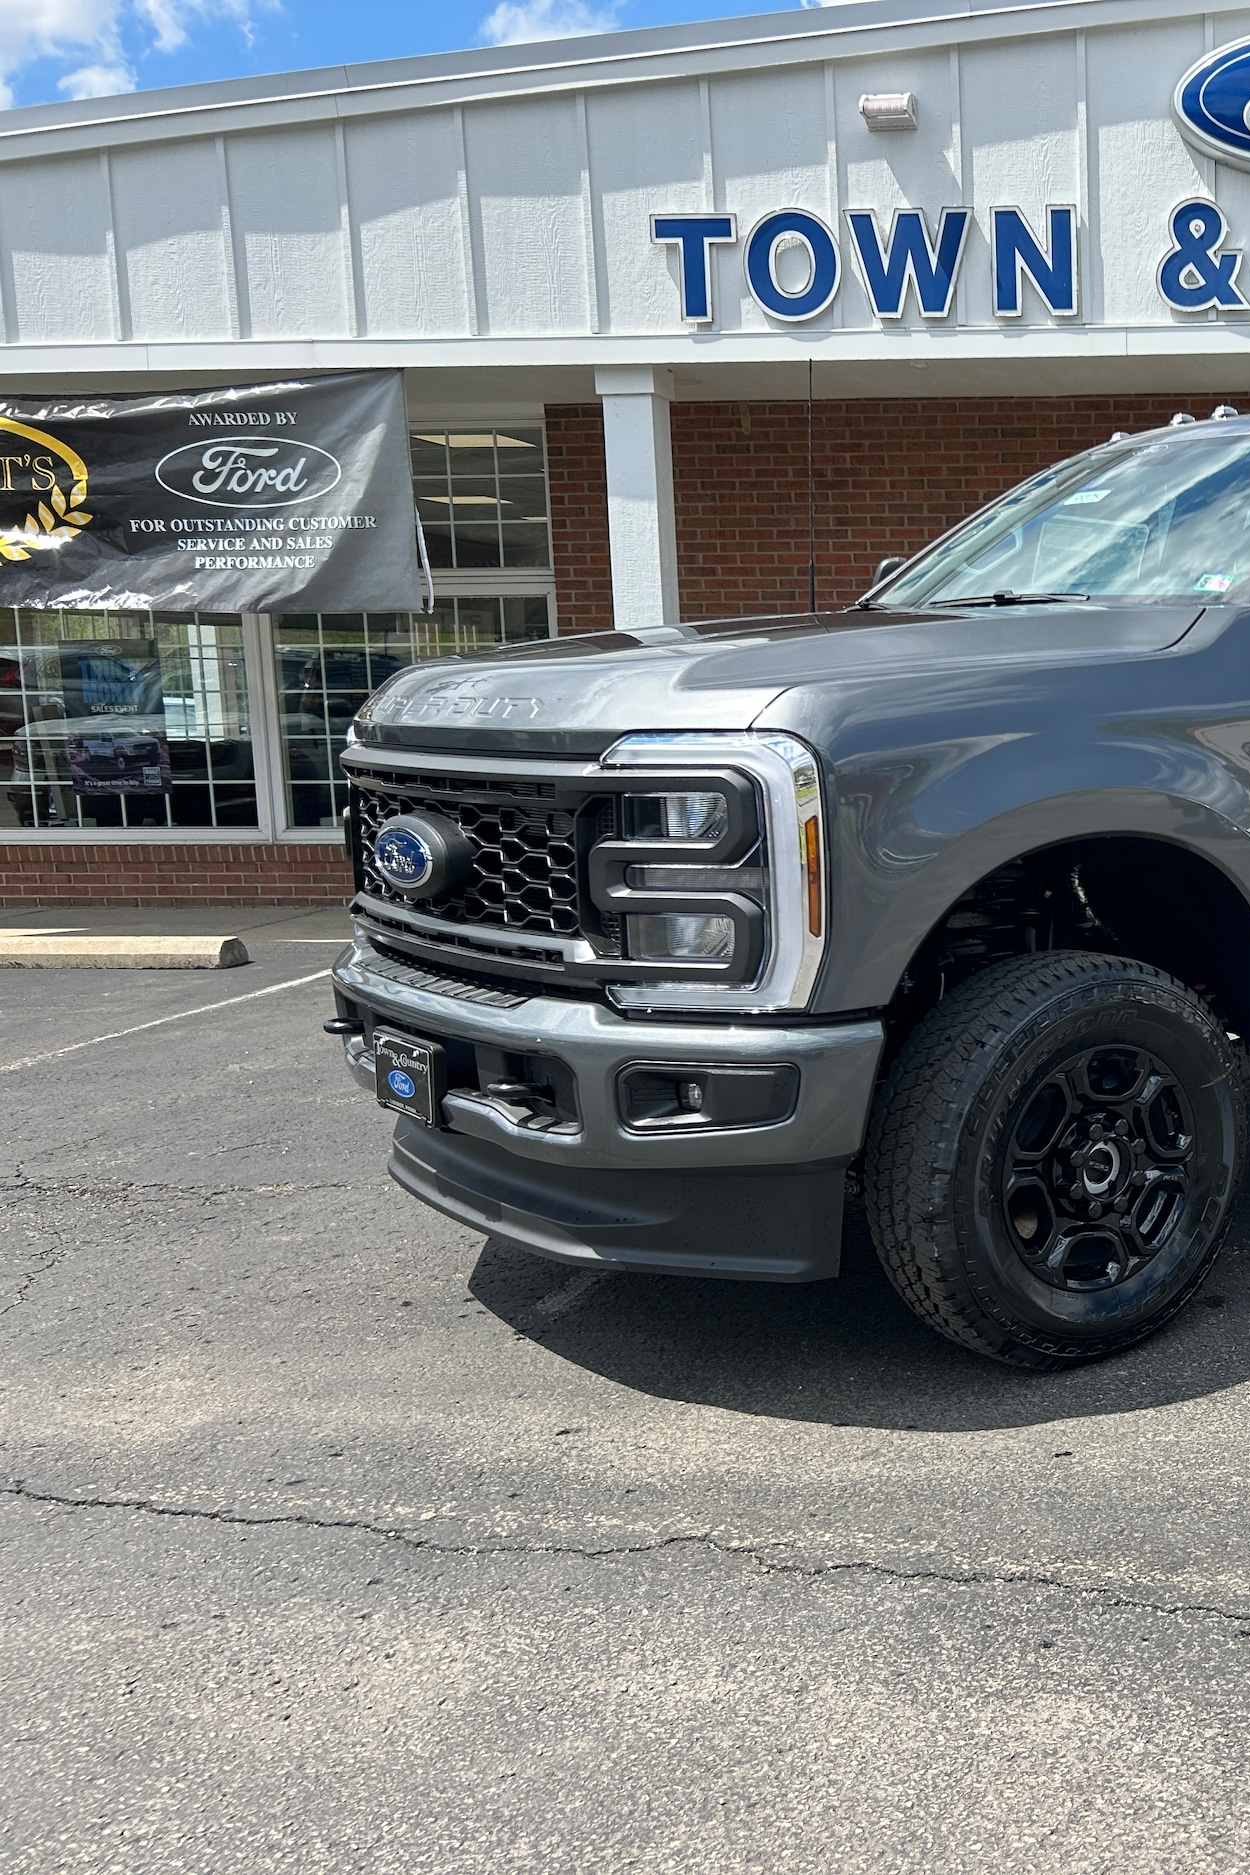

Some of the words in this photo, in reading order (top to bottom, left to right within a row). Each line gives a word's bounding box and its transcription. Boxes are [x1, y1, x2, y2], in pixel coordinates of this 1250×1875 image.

[650, 205, 1079, 325] TOWN
[188, 413, 271, 426] AWARDED
[275, 412, 298, 425] BY
[192, 446, 308, 494] Ford
[129, 519, 167, 533] FOR
[170, 518, 285, 532] OUTSTANDING
[288, 516, 378, 530] CUSTOMER
[177, 538, 246, 551] SERVICE
[250, 537, 283, 550] AND
[286, 535, 333, 549] SALES
[194, 555, 315, 570] PERFORMANCE
[91, 705, 114, 713] SALES
[115, 704, 138, 712] EVENT
[446, 696, 547, 719] DUTY
[380, 838, 416, 875] Ford
[375, 1040, 395, 1058] Town
[392, 1053, 402, 1068] &
[400, 1053, 428, 1075] Country
[394, 1073, 411, 1094] Ford
